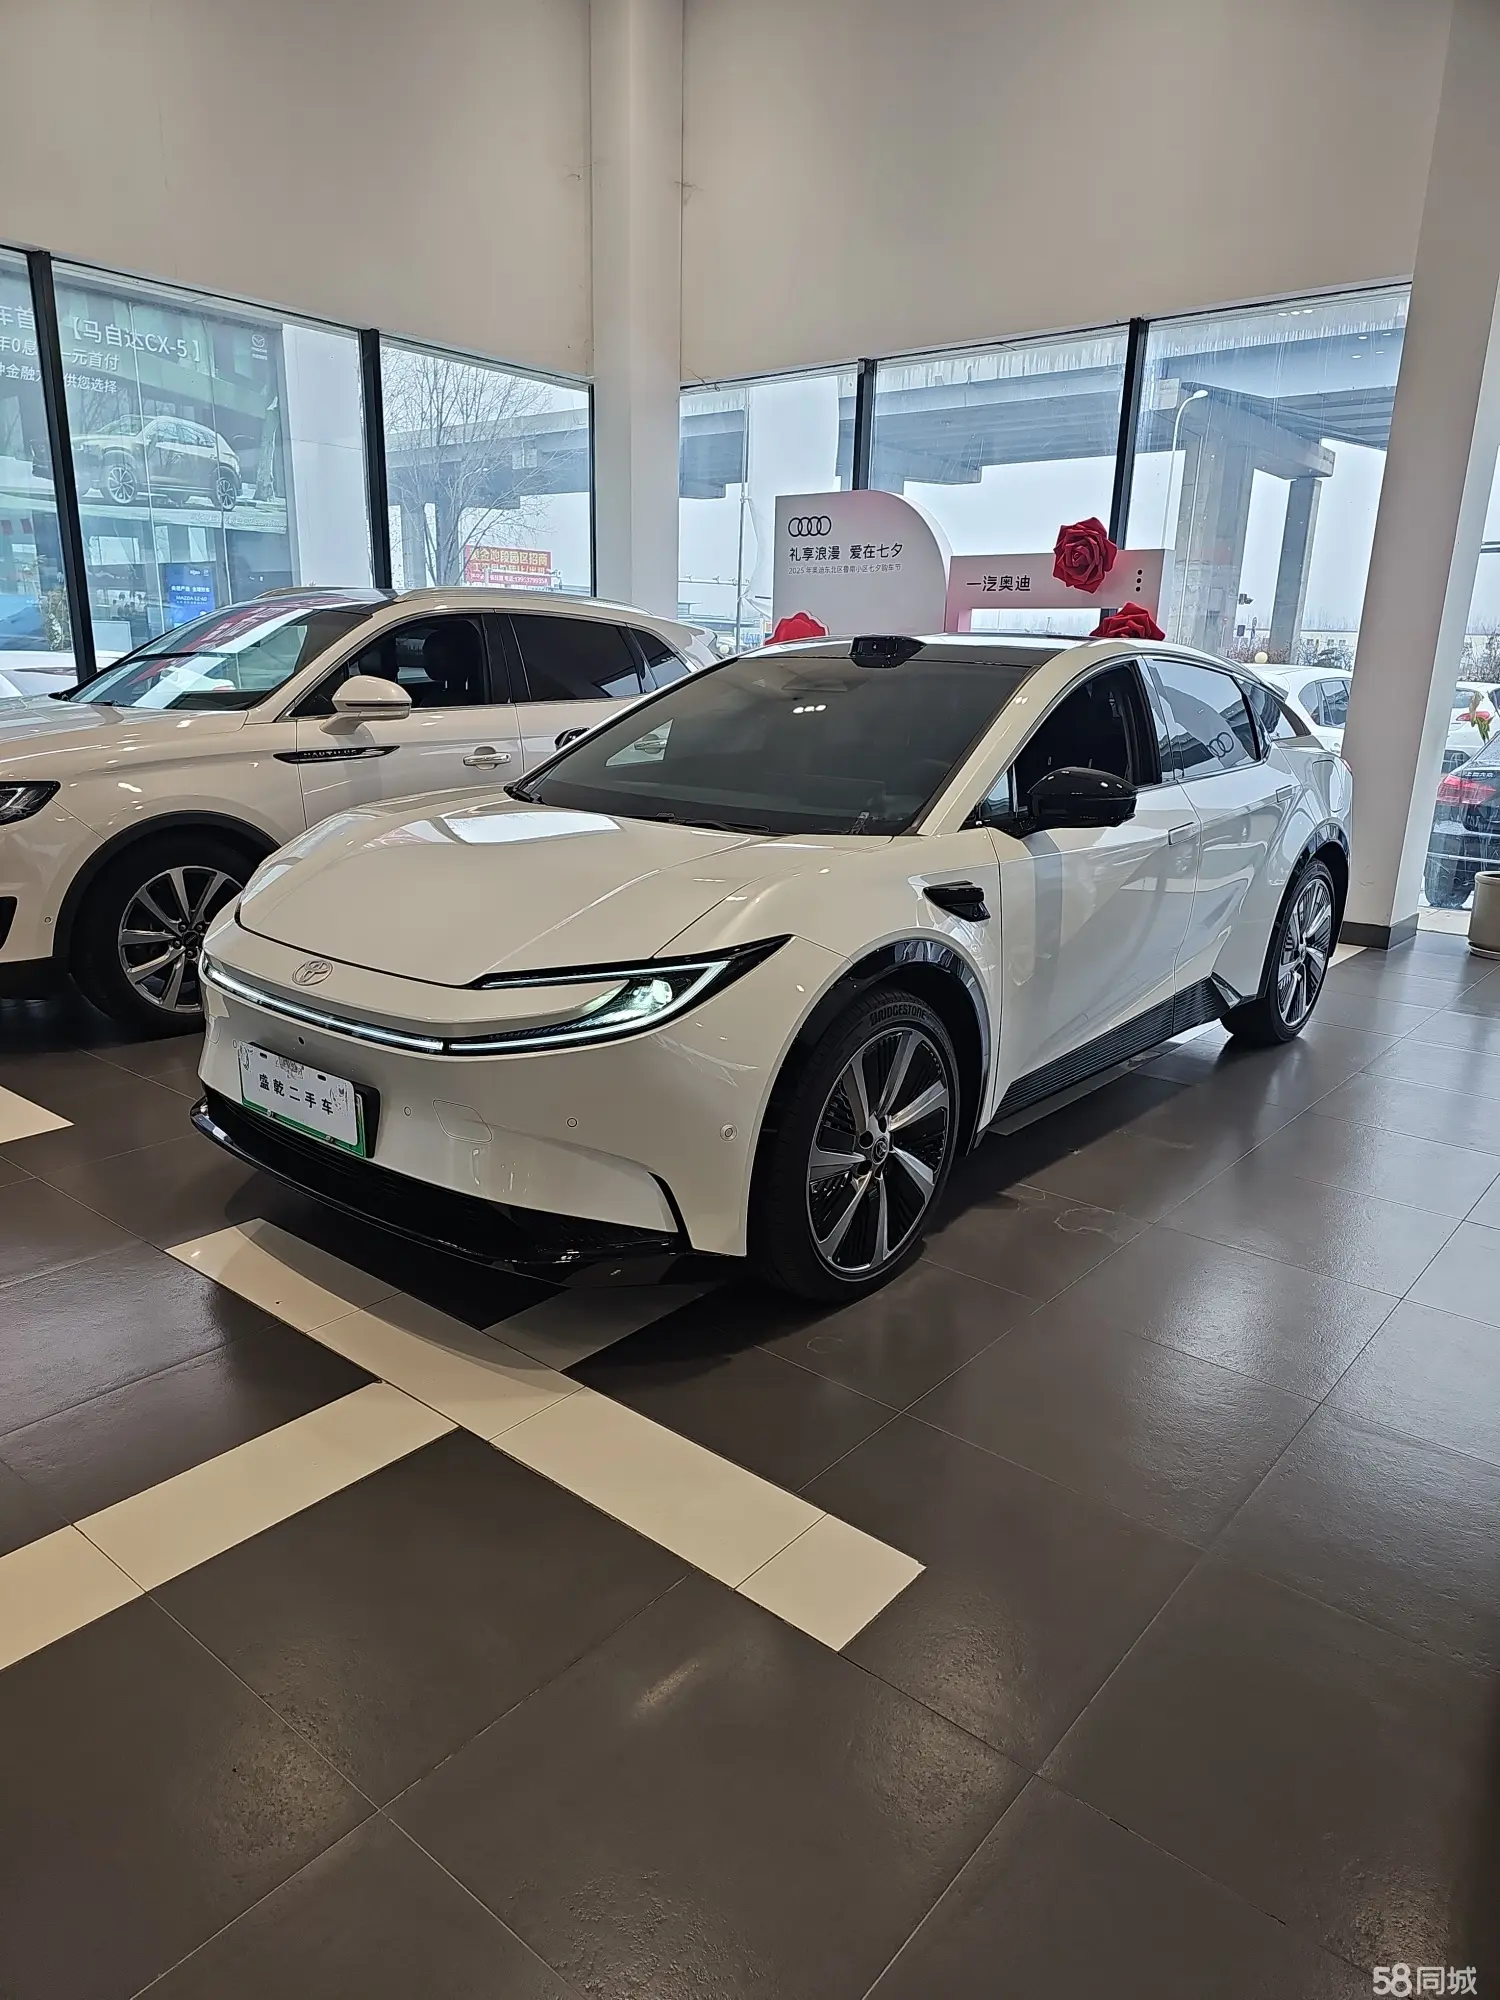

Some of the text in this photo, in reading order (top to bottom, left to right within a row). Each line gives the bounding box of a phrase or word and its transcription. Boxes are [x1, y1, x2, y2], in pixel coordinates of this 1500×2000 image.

[64, 372, 118, 394] 供您选择
[789, 542, 903, 561] 礼享浪漫 爱在七夕
[966, 575, 1031, 592] 一汽奥迪
[869, 1004, 926, 1027] BRIDGESTONE
[259, 1073, 334, 1115] 盛乾二手车
